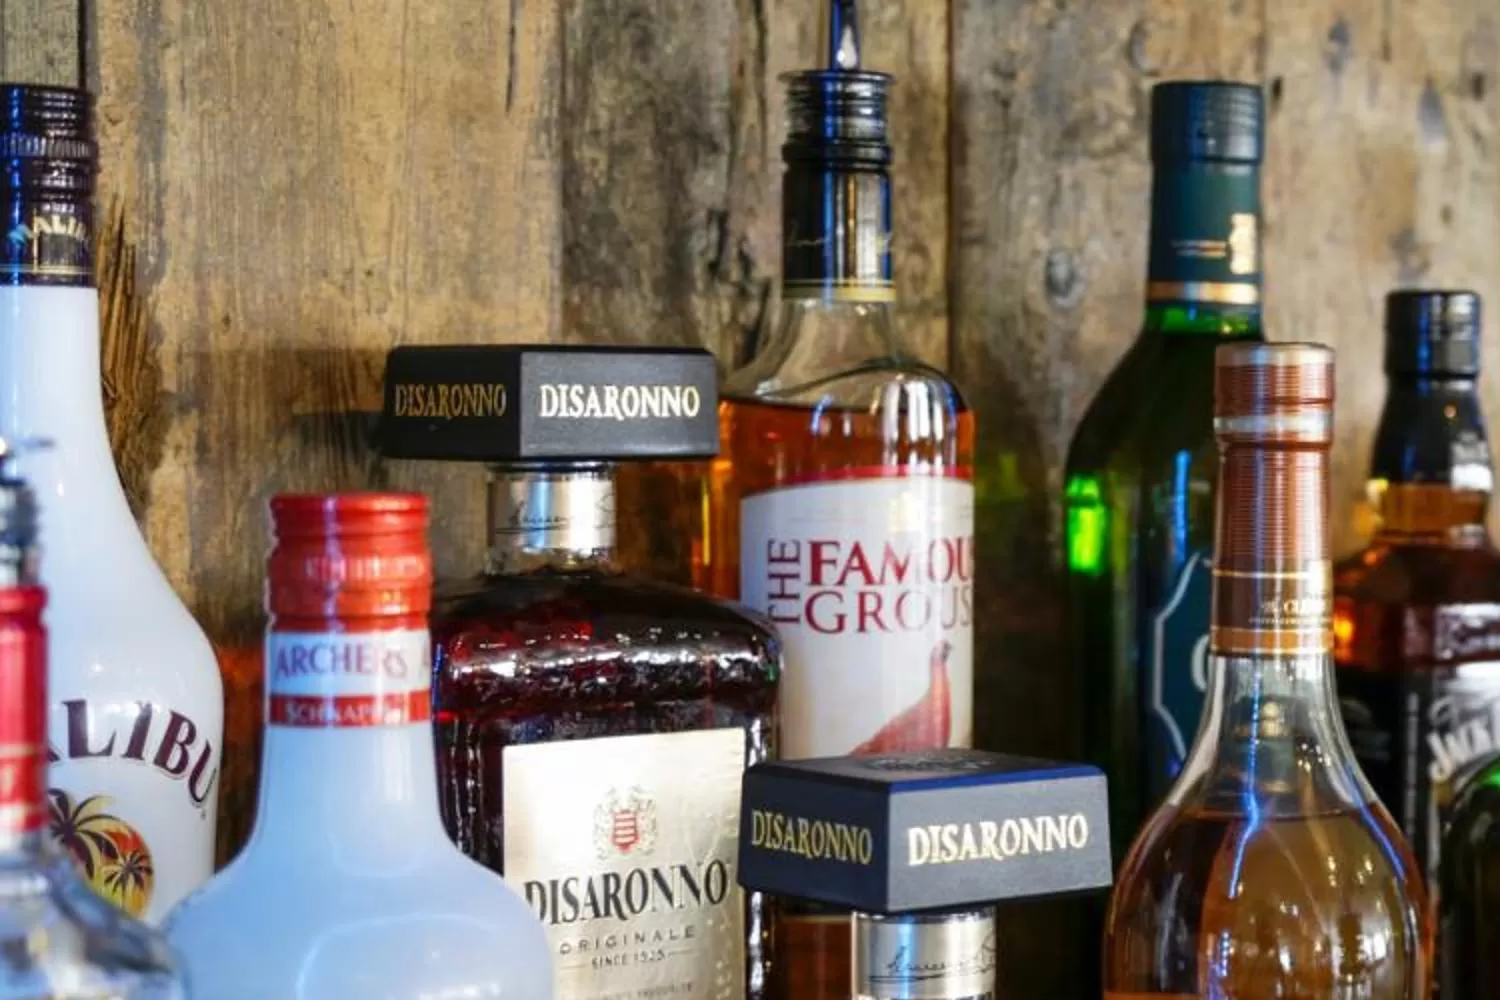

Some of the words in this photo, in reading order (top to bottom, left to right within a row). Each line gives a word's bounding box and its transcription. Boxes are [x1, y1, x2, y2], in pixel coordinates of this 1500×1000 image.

[395, 383, 507, 419] DISARONNO
[539, 383, 701, 421] DISARONNO
[767, 538, 801, 625] THE
[275, 641, 409, 681] ARCHERS
[47, 698, 218, 805] LIBU
[751, 808, 873, 866] DISARONNO
[908, 811, 1090, 868] DISARONNO
[523, 859, 729, 926] DISARONNO
[559, 924, 697, 956] ORIGINALE
